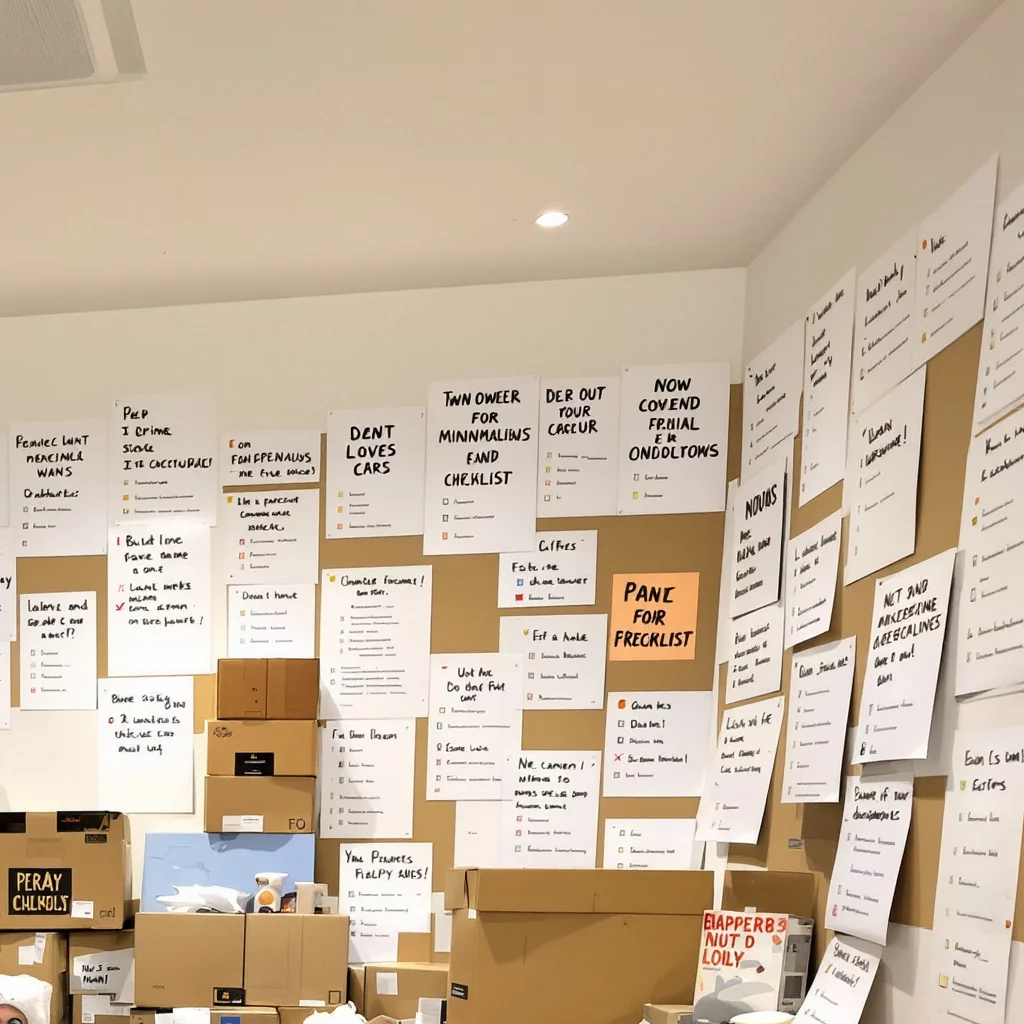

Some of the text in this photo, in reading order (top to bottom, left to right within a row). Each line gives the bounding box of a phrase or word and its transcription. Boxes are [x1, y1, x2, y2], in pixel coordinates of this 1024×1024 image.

[654, 378, 691, 392] NOW
[579, 386, 606, 401] OUT
[471, 412, 499, 424] FOR
[346, 444, 396, 459] LOVES
[354, 462, 391, 476] CARS
[288, 818, 306, 830] FO
